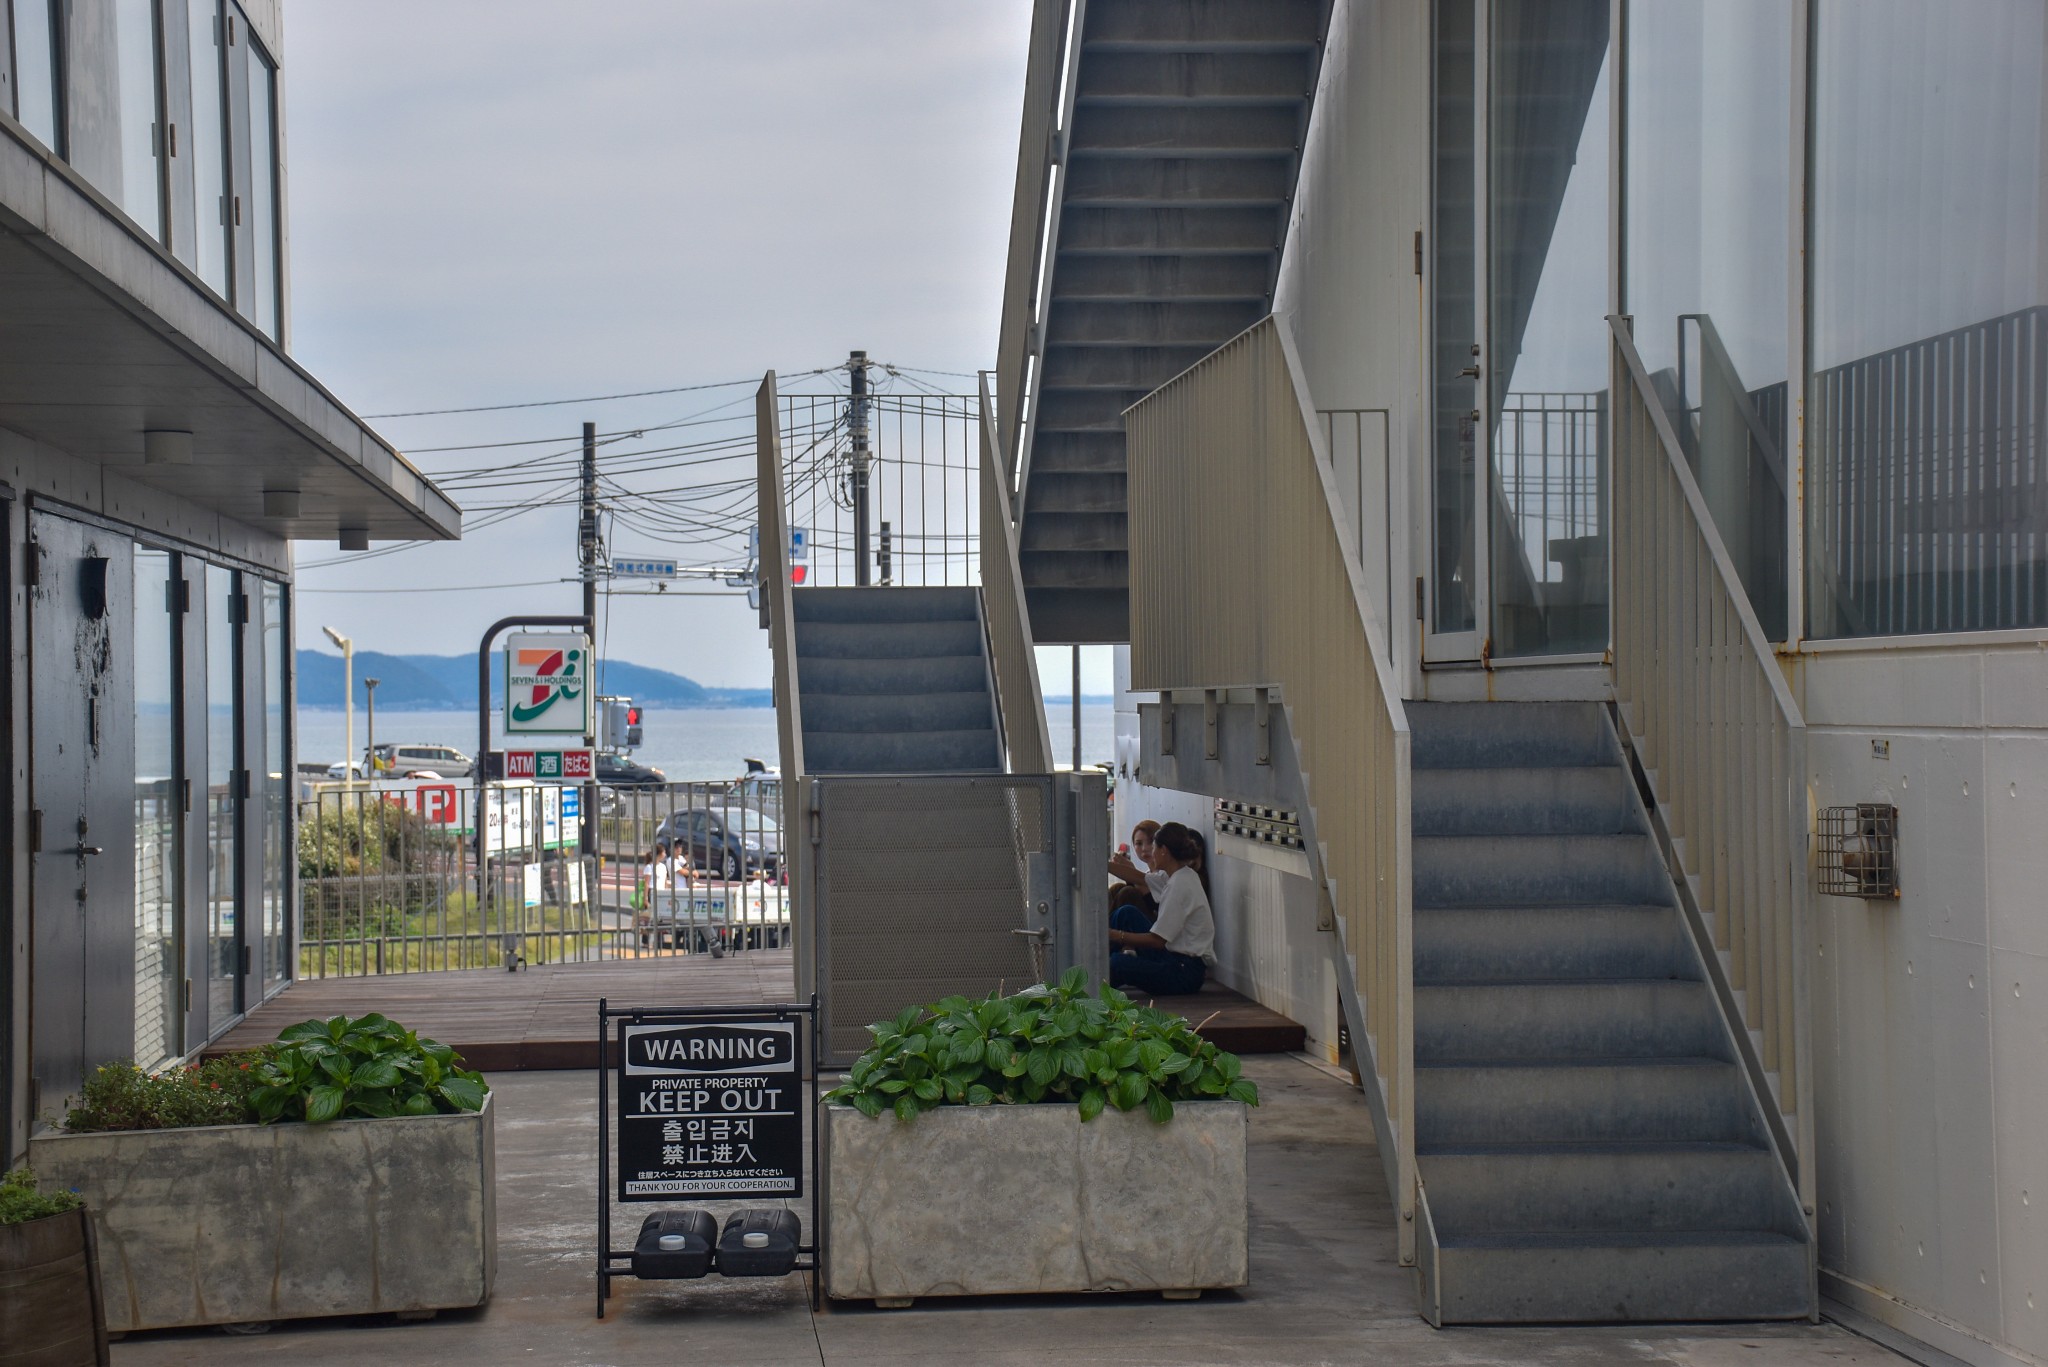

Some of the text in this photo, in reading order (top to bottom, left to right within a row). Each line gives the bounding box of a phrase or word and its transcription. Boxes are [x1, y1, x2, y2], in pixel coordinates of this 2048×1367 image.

[544, 676, 582, 685] HOLDINGS
[509, 756, 534, 774] ATM
[540, 756, 557, 774] 酒
[564, 755, 590, 773] たばこ
[643, 1037, 776, 1061] WARNING
[652, 1077, 768, 1090] PRIVATE PROPERTY
[640, 1088, 782, 1113] KEEP OUT
[661, 1118, 754, 1142] 출입금지
[661, 1143, 757, 1166] 禁止进入
[628, 1180, 793, 1192] THANK YOU FOR YOUR COOPERATION.
